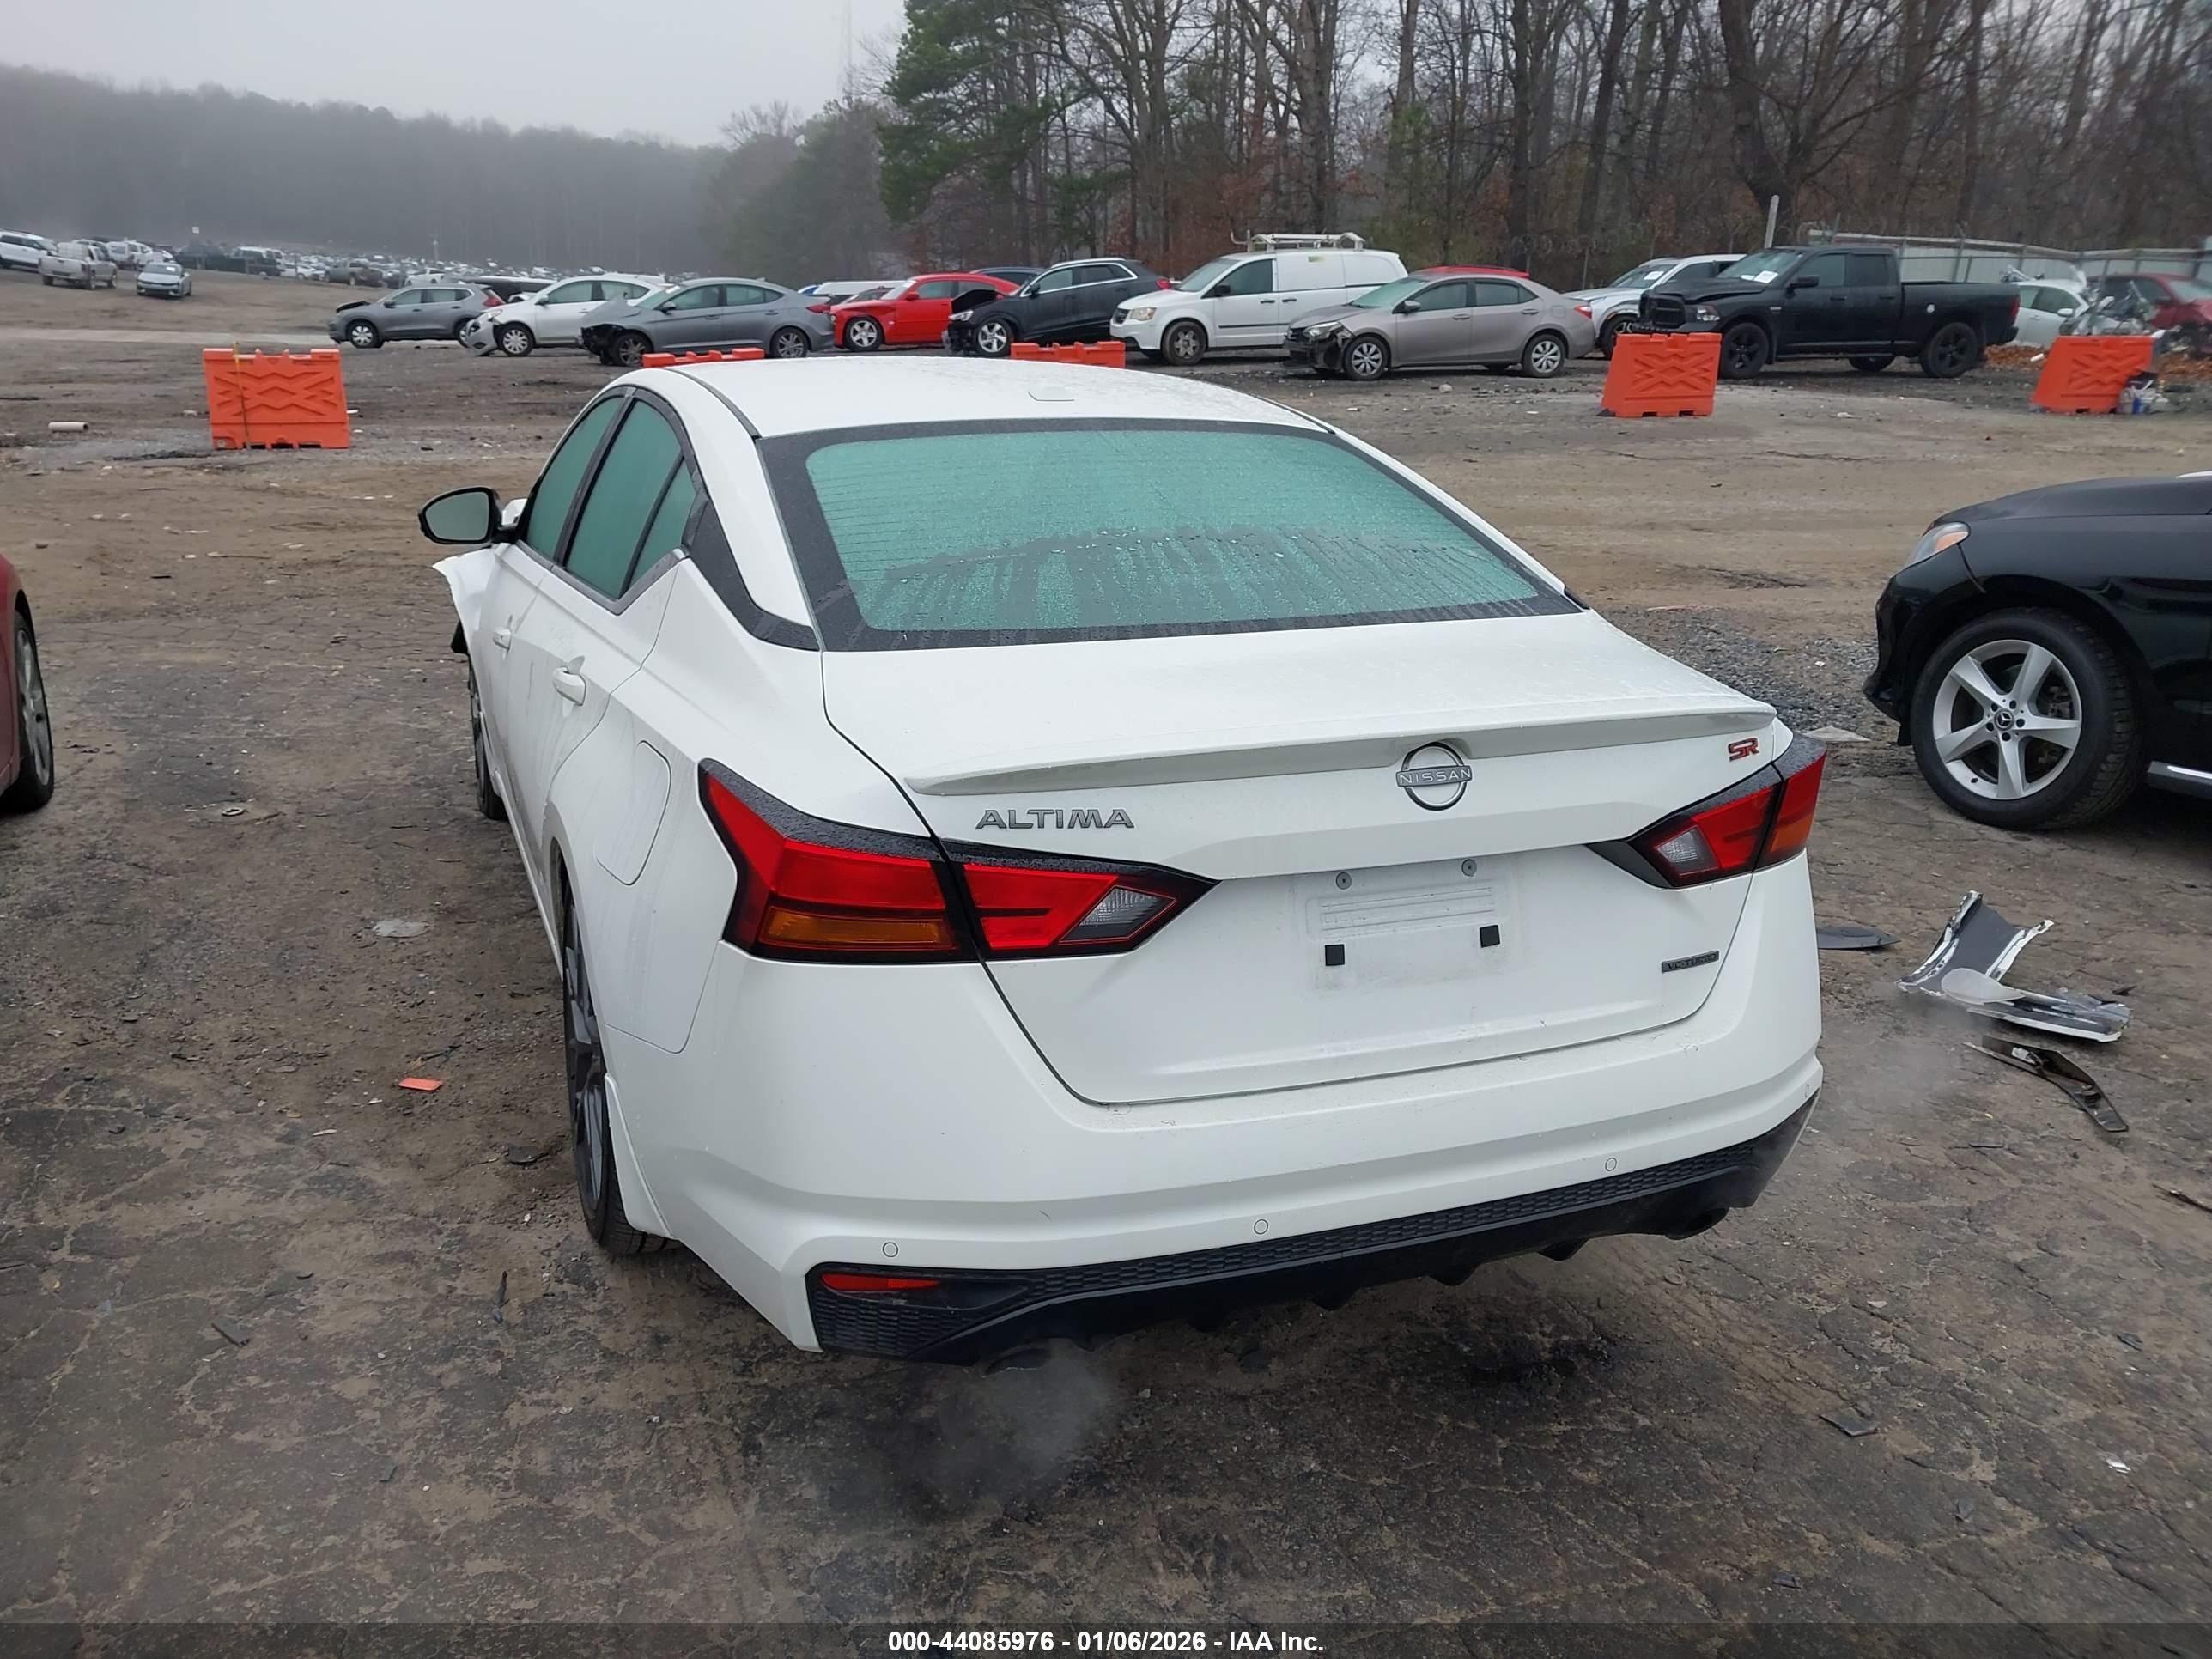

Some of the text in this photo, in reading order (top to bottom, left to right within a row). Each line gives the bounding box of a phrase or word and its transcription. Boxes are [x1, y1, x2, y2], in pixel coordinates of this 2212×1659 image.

[1728, 737, 1759, 762] SR
[1399, 768, 1471, 784] NISSAN
[975, 809, 1135, 830] ALTIMA
